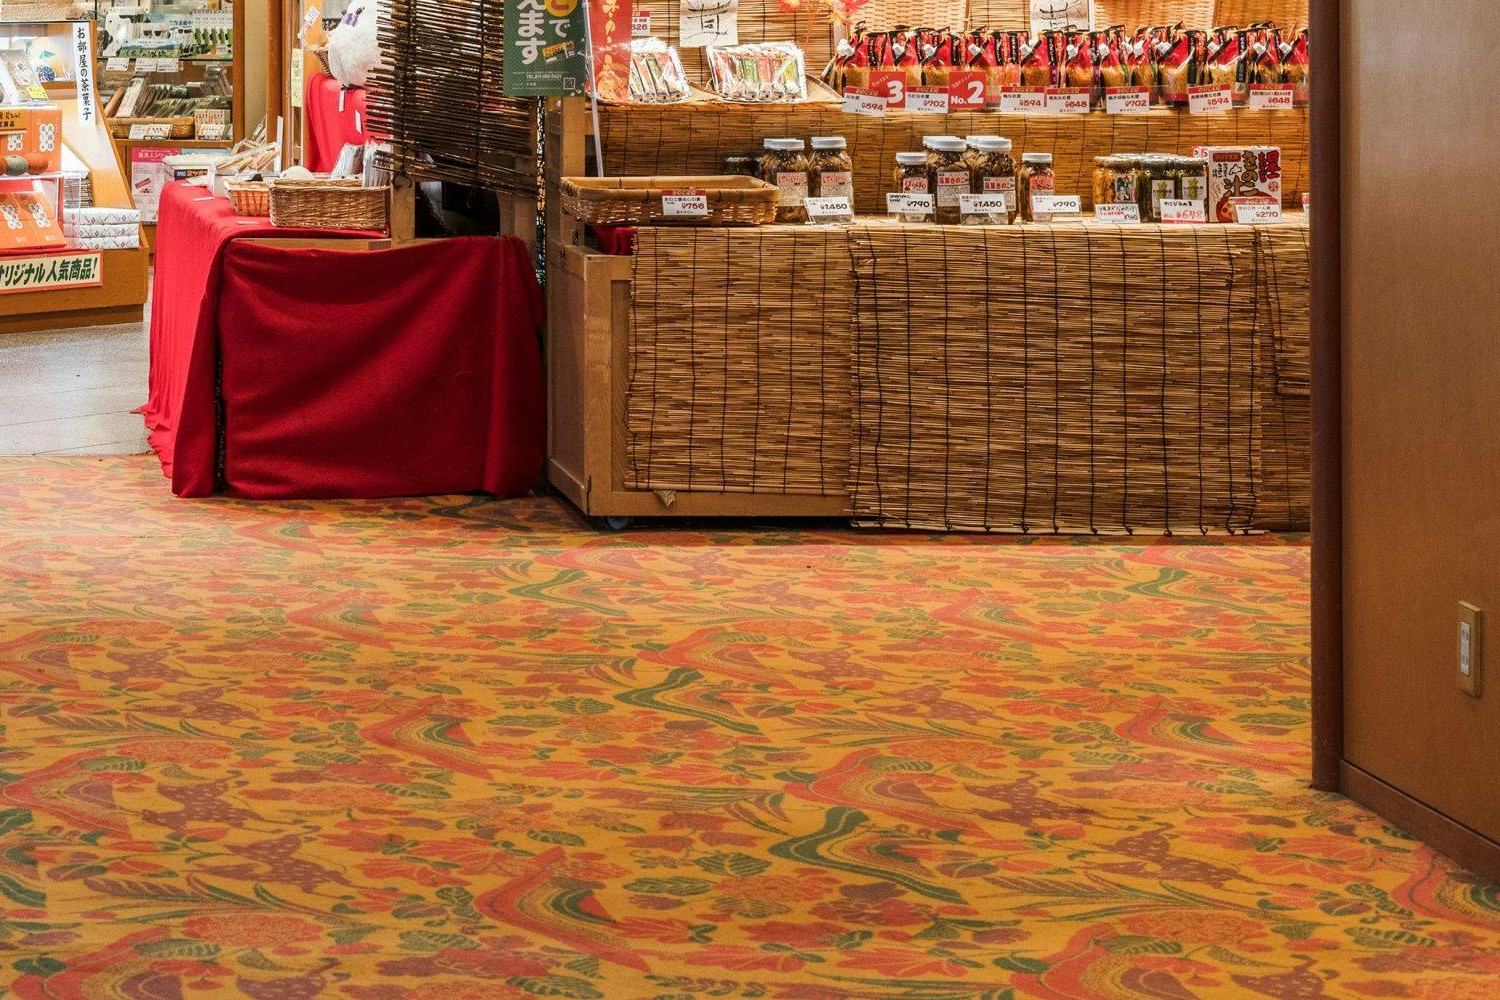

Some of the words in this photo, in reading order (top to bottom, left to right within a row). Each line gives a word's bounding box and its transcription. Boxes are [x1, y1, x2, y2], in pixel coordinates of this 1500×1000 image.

[77, 27, 92, 121] お部屋の茶菓子
